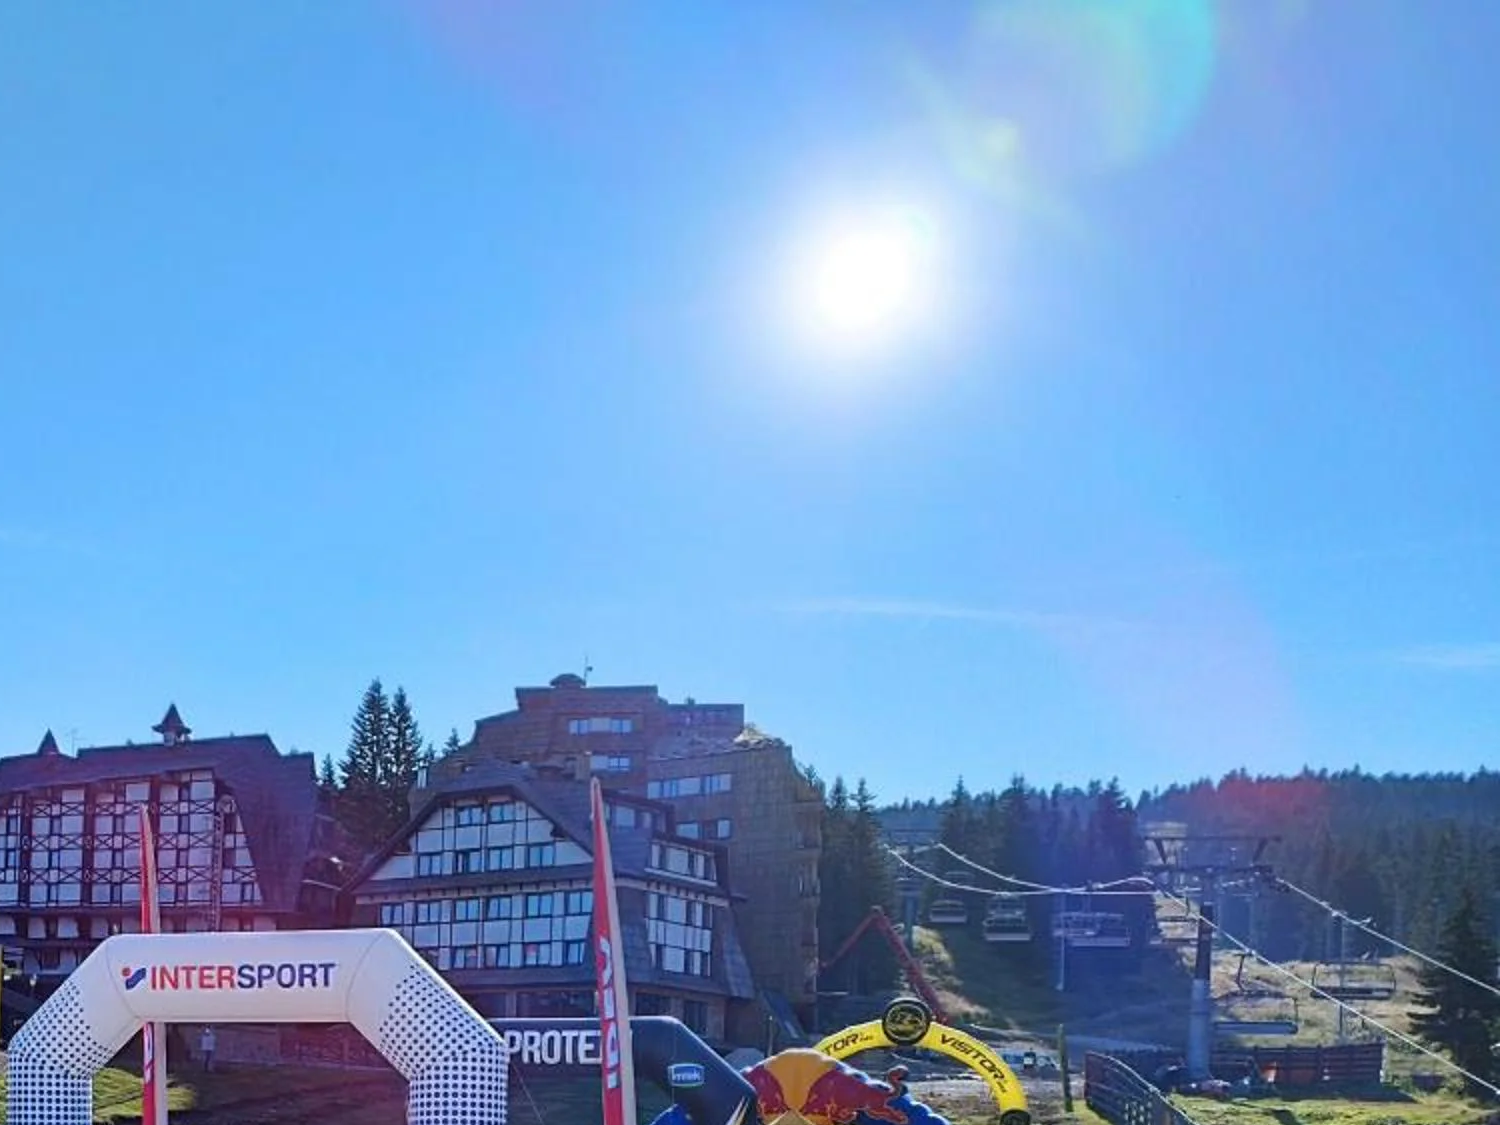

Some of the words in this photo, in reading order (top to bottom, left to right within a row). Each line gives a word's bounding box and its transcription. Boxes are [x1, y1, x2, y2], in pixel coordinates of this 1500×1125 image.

[151, 962, 336, 990] INTERSPORT
[503, 1028, 603, 1065] PROTE
[939, 1033, 1005, 1082] VISITOR
